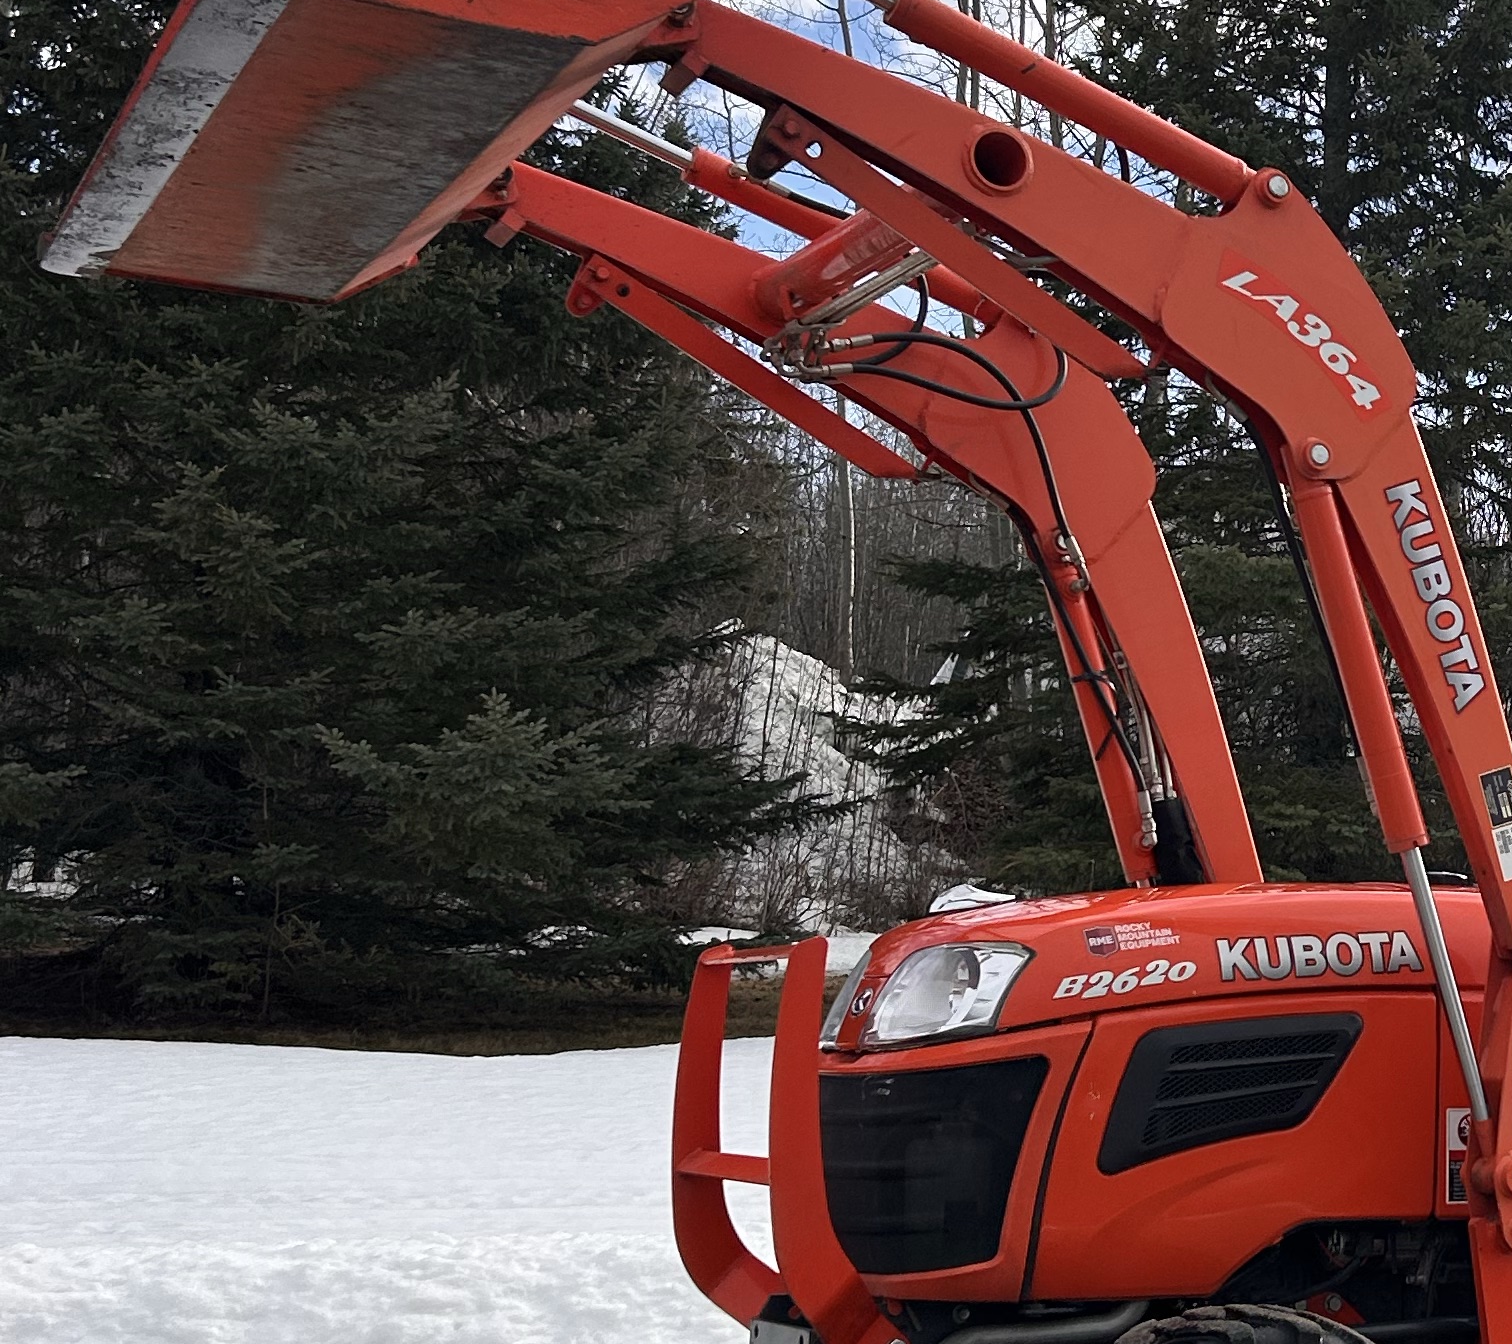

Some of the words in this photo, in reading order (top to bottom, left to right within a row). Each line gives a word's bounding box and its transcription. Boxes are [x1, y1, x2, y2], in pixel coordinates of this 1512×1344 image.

[1221, 271, 1381, 410] LA364
[1384, 479, 1485, 714] KUBOTA
[1088, 935, 1115, 947] RME
[1114, 922, 1151, 933] ROCKY
[1117, 928, 1172, 942] MOUNTAIN
[1120, 936, 1180, 951] EQUIPMENT
[1216, 931, 1424, 981] KUBOTA
[1052, 959, 1197, 999] B2620
